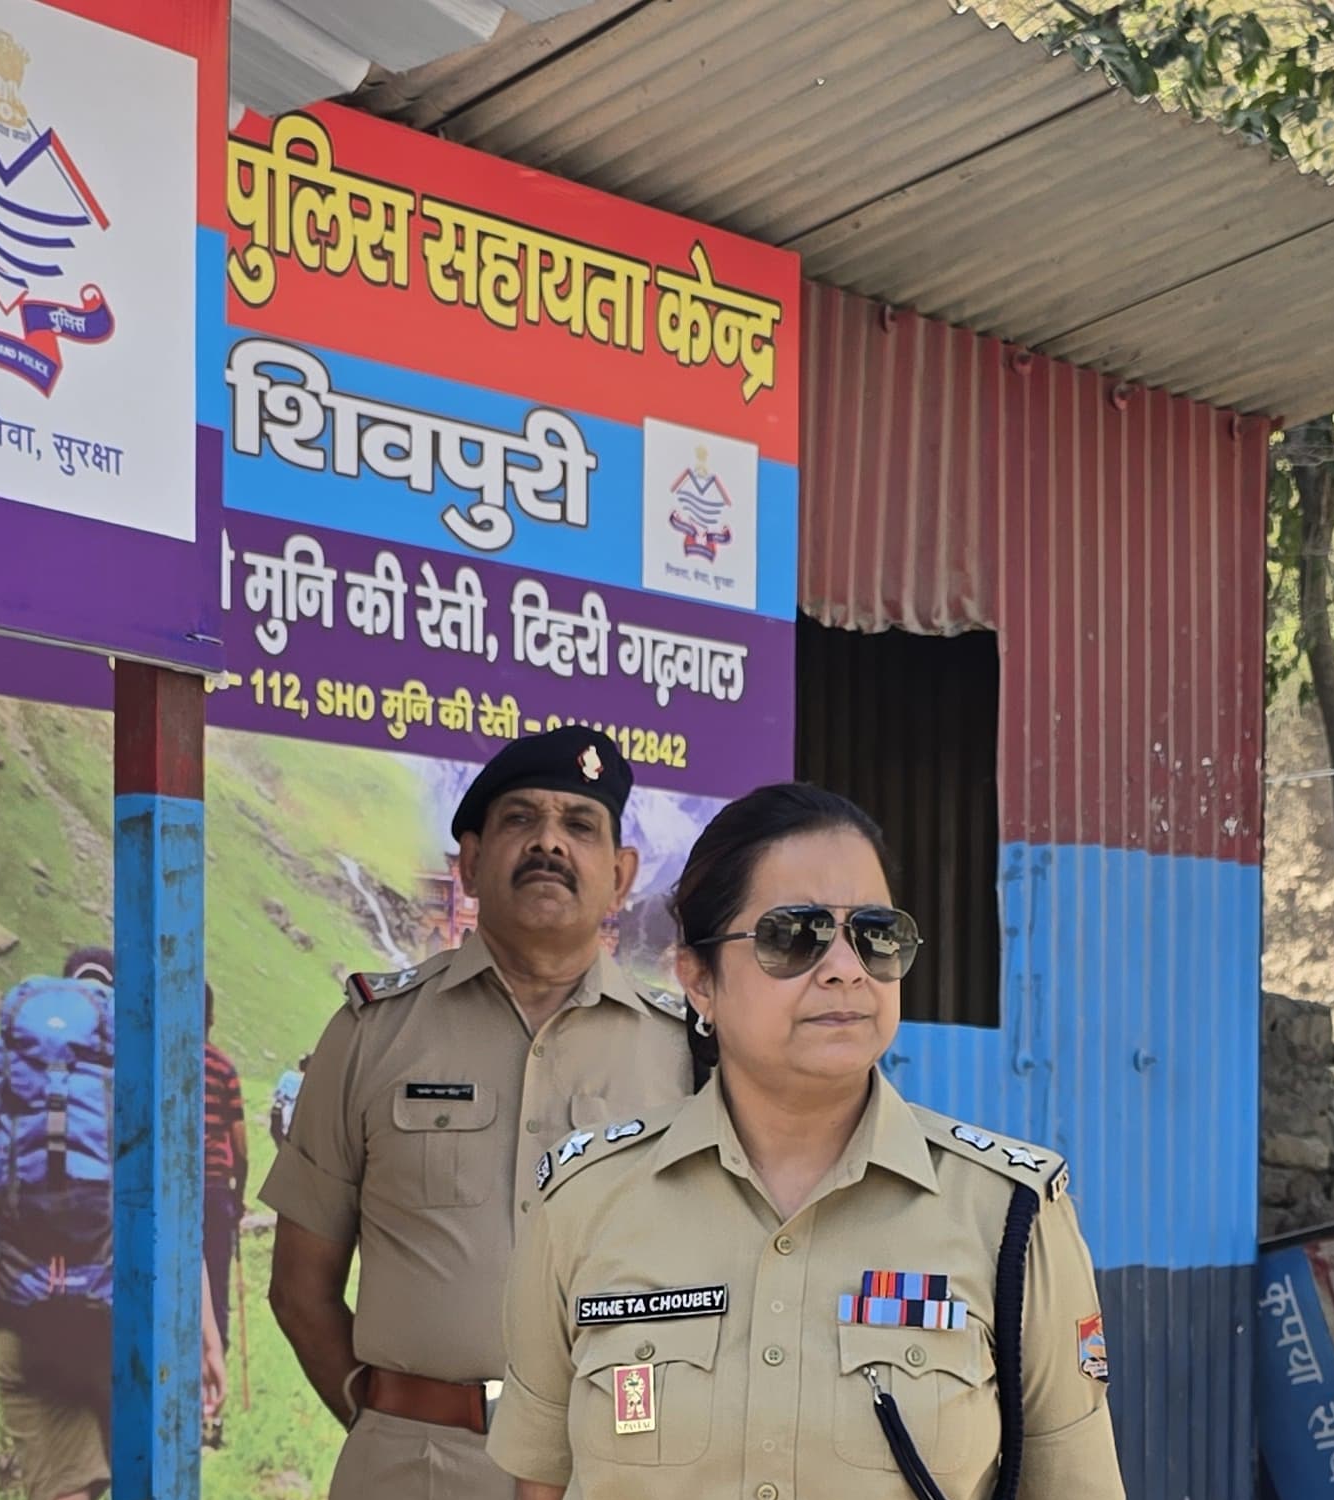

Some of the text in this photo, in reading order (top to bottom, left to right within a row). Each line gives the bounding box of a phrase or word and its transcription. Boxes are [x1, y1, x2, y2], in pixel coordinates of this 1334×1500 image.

[228, 113, 782, 402] पुलिस सहायता केन्द्र
[49, 308, 86, 333] पुलिस
[53, 432, 124, 476] सुरक्षा
[225, 340, 597, 550] शिवपुरी
[243, 535, 337, 654] मुनि
[345, 552, 407, 640] की
[416, 561, 498, 662] रेती,
[511, 579, 609, 676] टिहरी
[617, 623, 747, 706] गढ़वाल
[250, 669, 309, 719] 112,
[317, 679, 375, 720] SHO
[381, 680, 434, 739] मुनि
[438, 688, 474, 732] की
[479, 694, 520, 739] रेती
[581, 1290, 723, 1317] SHWETA CHOUBEY
